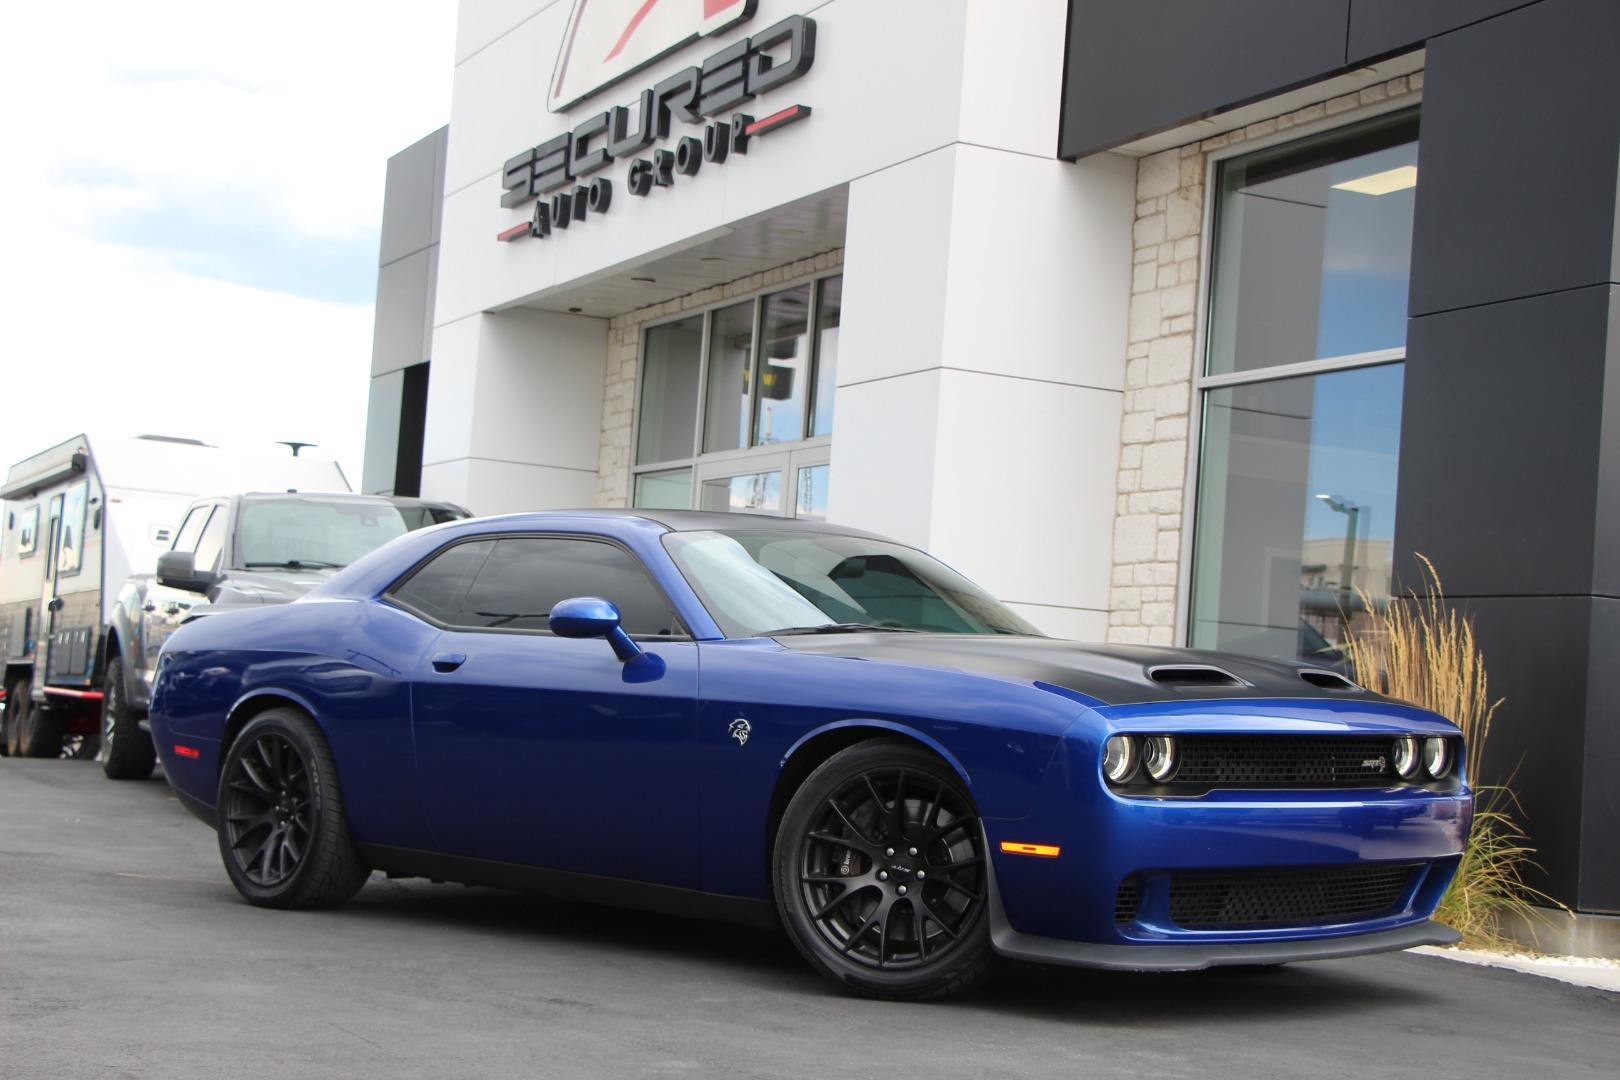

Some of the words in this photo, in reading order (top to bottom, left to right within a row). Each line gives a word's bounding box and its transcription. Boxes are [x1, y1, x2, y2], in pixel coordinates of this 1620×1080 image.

[501, 14, 817, 208] SECURED
[529, 176, 612, 238] AUTO
[628, 113, 754, 196] GROUP
